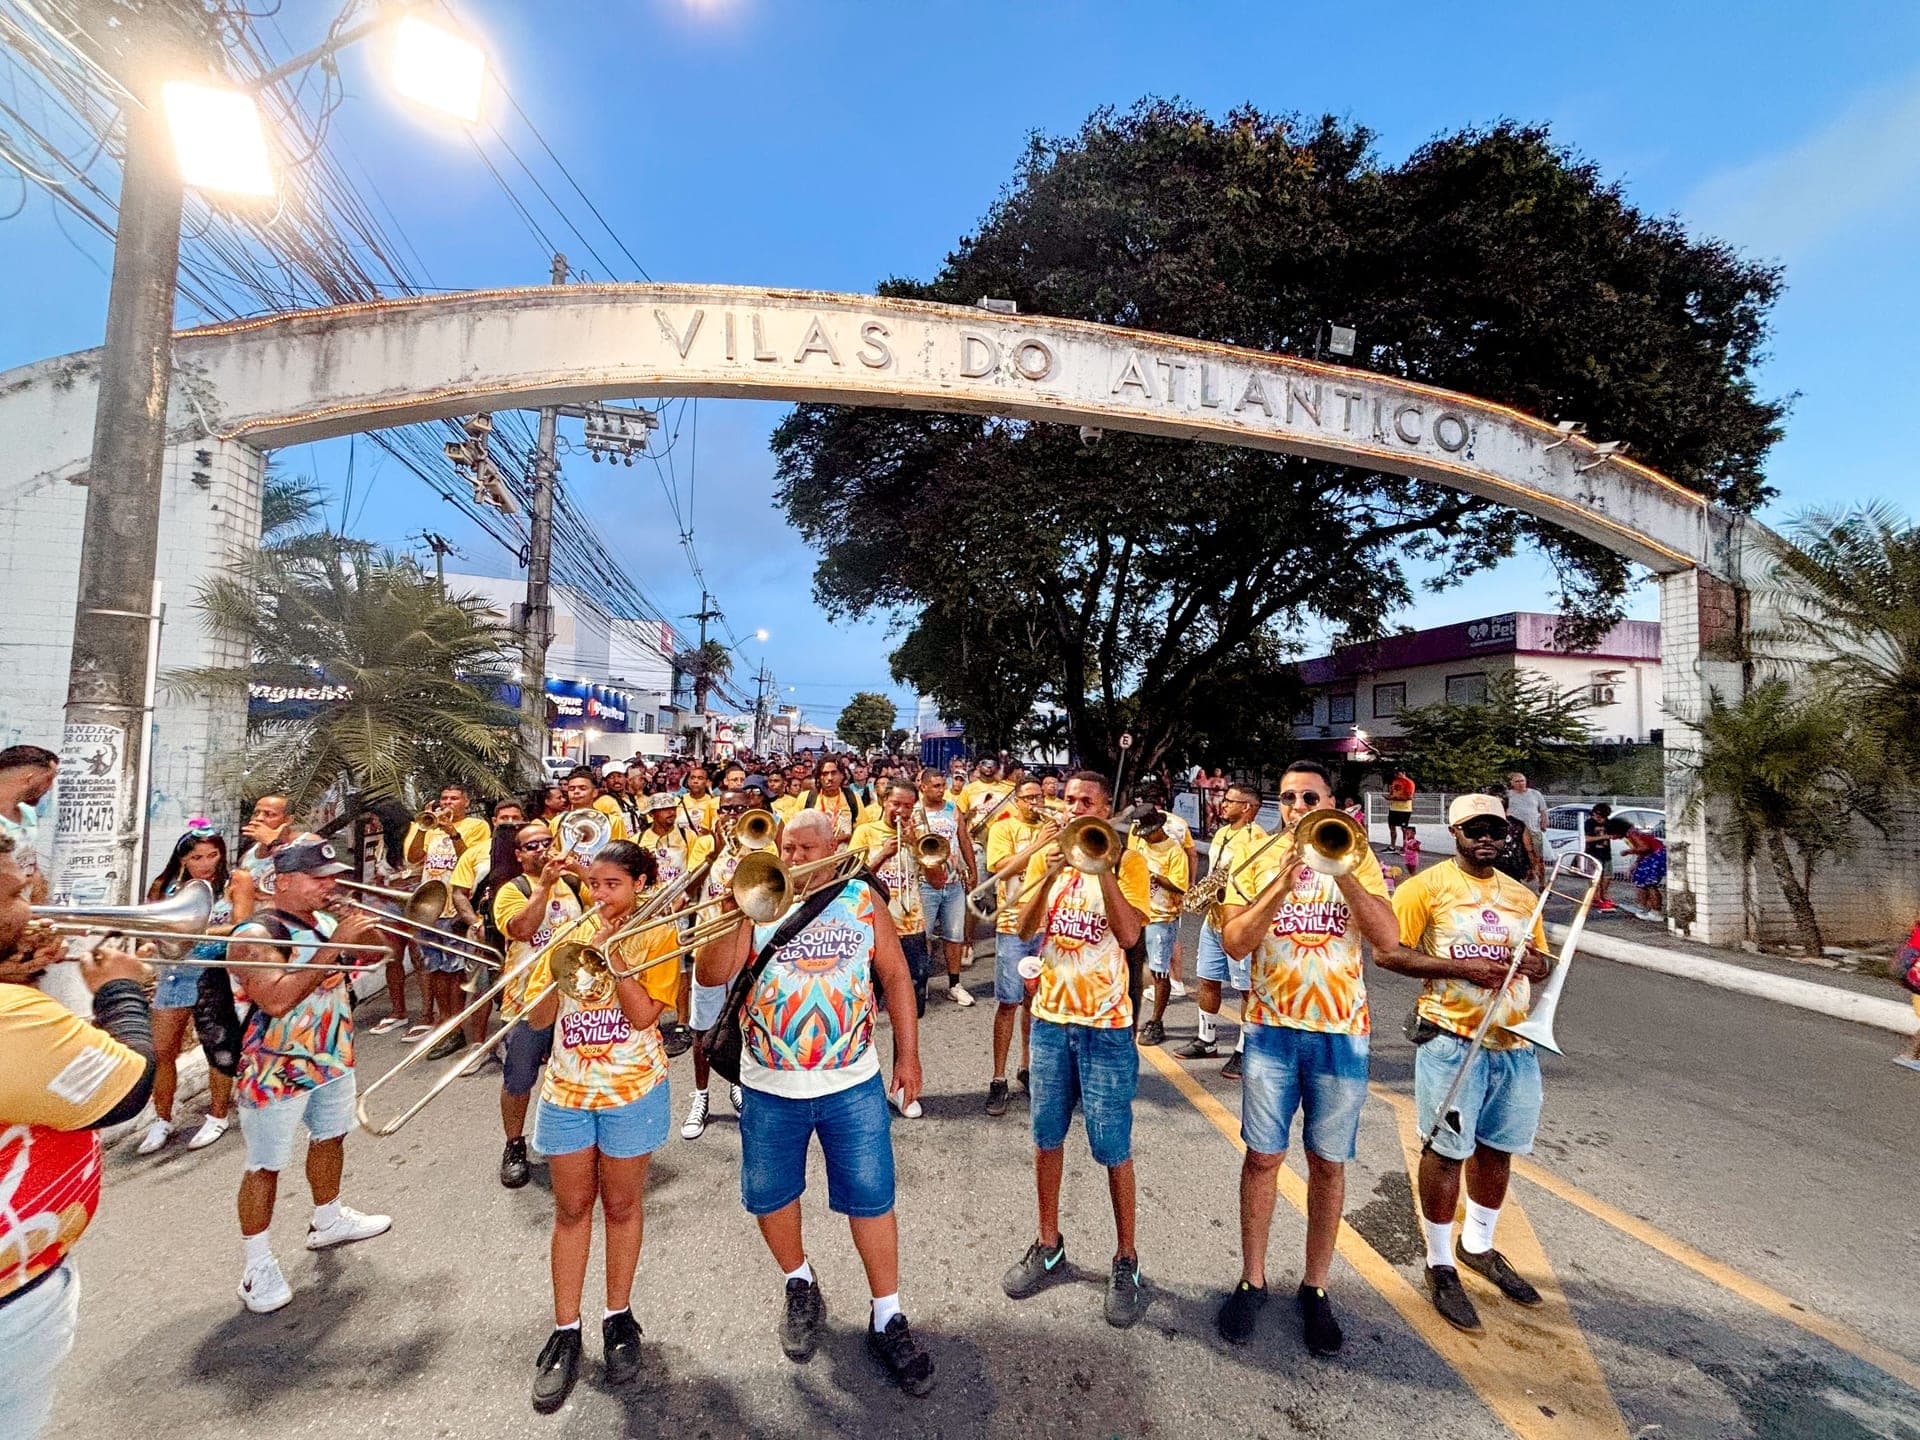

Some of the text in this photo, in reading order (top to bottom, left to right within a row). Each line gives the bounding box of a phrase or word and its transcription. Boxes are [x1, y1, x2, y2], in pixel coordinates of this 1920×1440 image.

[653, 309, 1470, 452] VILAS DO ATLANTICO
[1491, 622, 1515, 638] Pet
[75, 734, 114, 743] OXUM
[1060, 919, 1104, 942] VILLAS
[1289, 916, 1346, 934] VILLAS
[775, 930, 864, 950] OQUINHO
[797, 943, 858, 957] VILLAS
[577, 1023, 630, 1042] VILLAS
